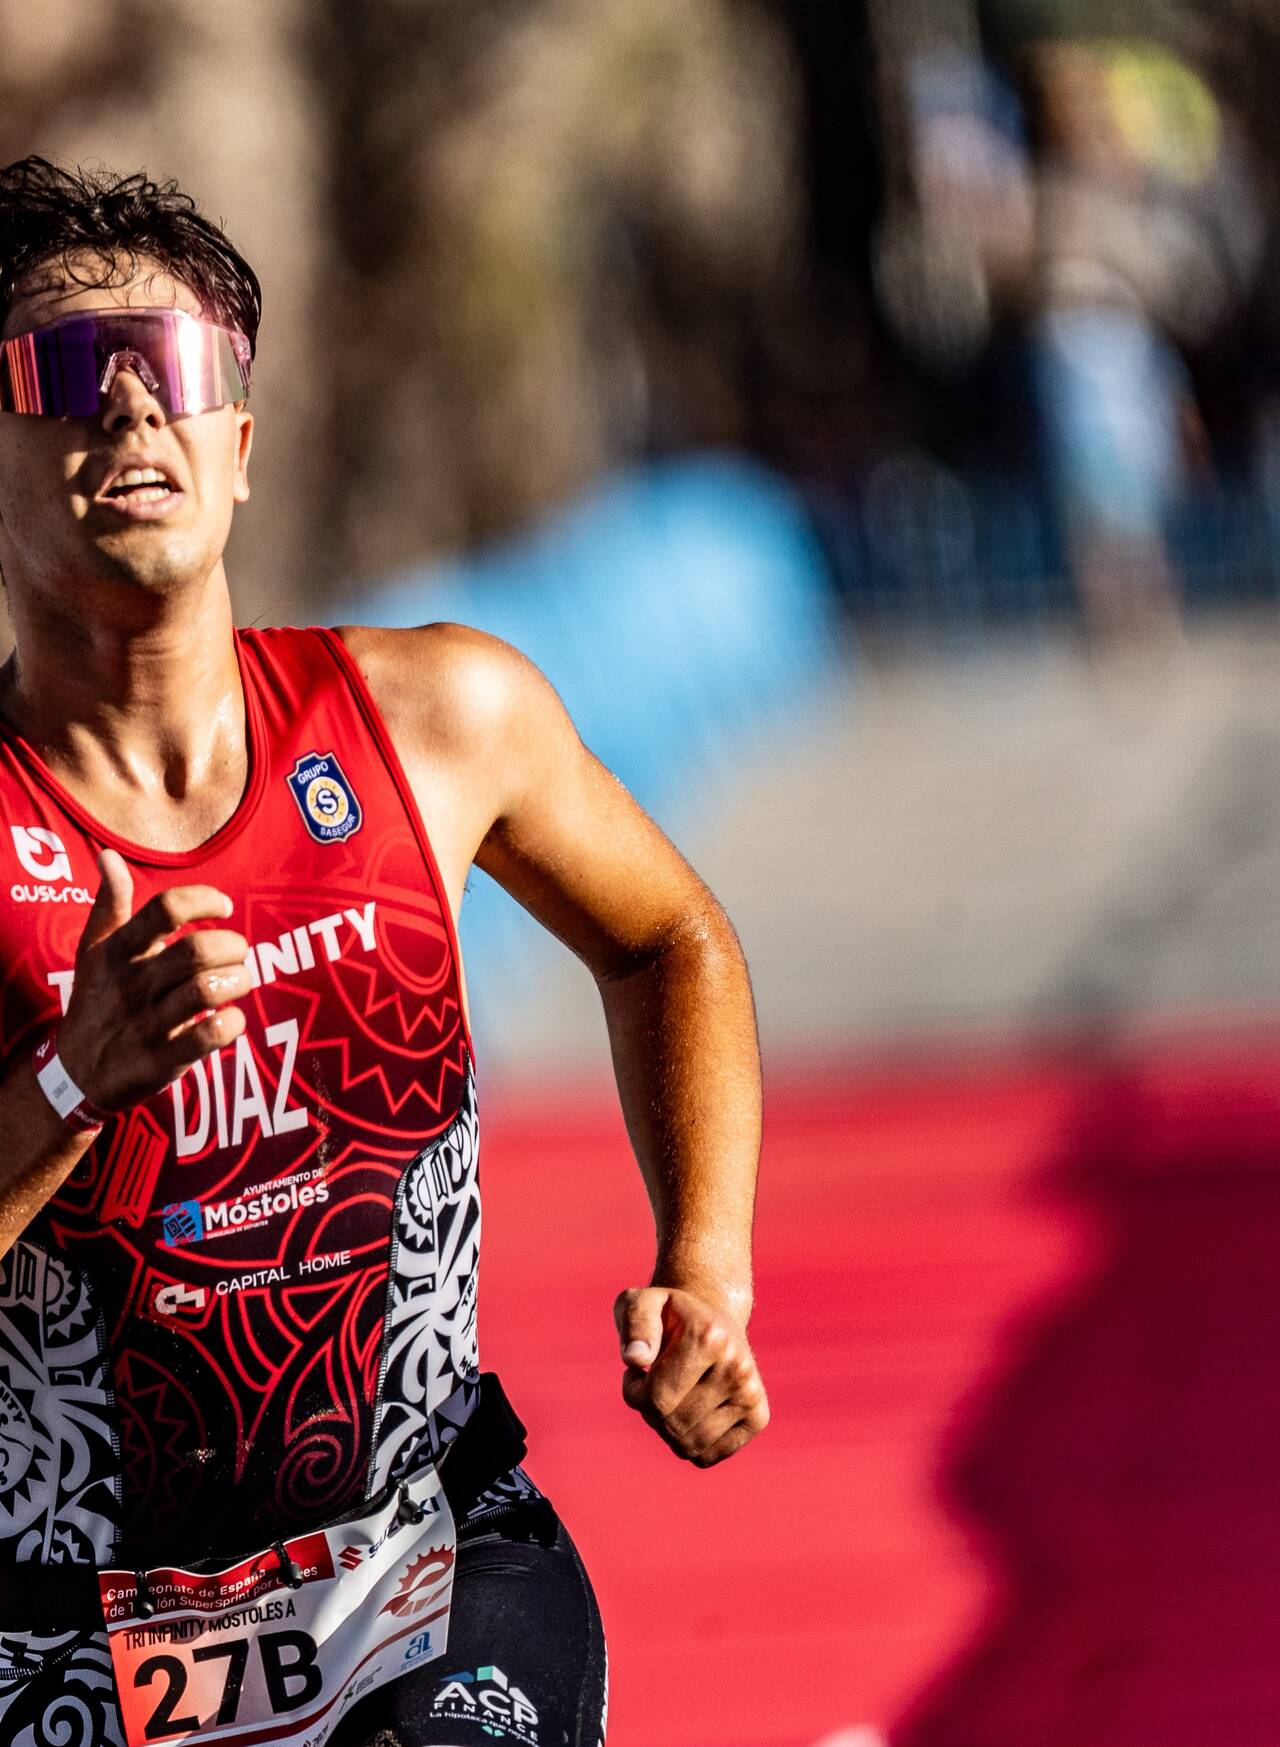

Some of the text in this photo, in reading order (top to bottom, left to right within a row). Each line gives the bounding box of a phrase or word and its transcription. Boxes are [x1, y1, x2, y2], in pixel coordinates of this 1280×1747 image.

[297, 761, 329, 785] GRUPO
[317, 789, 338, 814] S
[320, 813, 356, 837] SASEGUR
[10, 884, 96, 905] austral
[244, 901, 377, 990] INITY
[243, 1168, 325, 1197] AYUNTAMIENTO DE
[204, 1182, 330, 1231] Móstoles
[215, 1249, 352, 1296] CAPITAL HOME
[106, 1568, 266, 1601] Cameonato de España
[109, 1602, 125, 1618] de
[179, 1588, 250, 1609] SuperSprint
[253, 1580, 272, 1596] por
[122, 1598, 297, 1652] TRI INFINITY MÓSTOLES A
[133, 1629, 324, 1741] 27B
[433, 1681, 539, 1726] ACP
[429, 1711, 442, 1719] La
[444, 1711, 488, 1725] hipoteca
[433, 1702, 539, 1742] FINANCE
